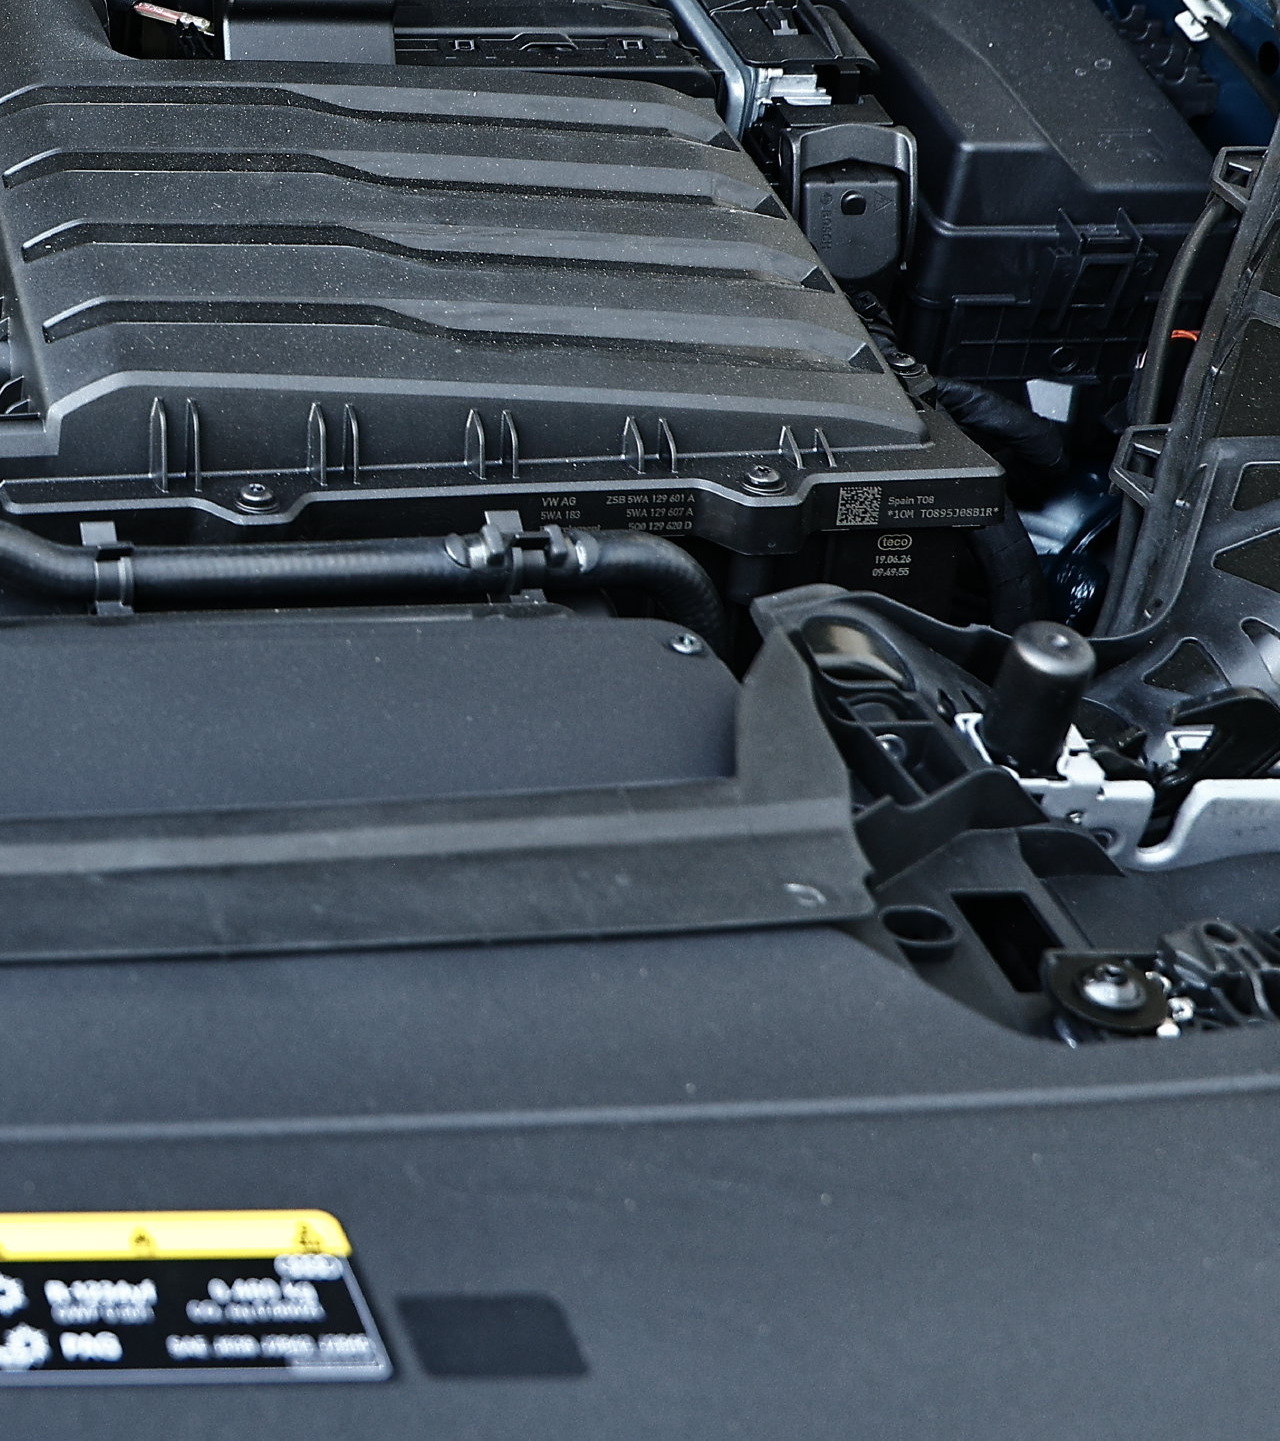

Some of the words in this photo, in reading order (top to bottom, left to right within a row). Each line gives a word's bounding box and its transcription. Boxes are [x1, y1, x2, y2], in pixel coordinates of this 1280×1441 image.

[541, 496, 560, 507] VW
[560, 496, 577, 506] AG
[606, 495, 626, 505] ZSB
[627, 495, 649, 504] 5WA
[652, 494, 668, 503] 129
[669, 494, 685, 503] 601
[686, 494, 696, 503] A
[887, 496, 915, 505] Spain
[540, 510, 562, 520] 5WA
[565, 510, 581, 519] 183
[626, 508, 648, 518] 5WA
[650, 508, 666, 517] 129
[667, 507, 685, 517] 607
[685, 507, 694, 516] A
[648, 521, 665, 530] 129
[684, 520, 693, 530] D
[882, 536, 909, 547] teco
